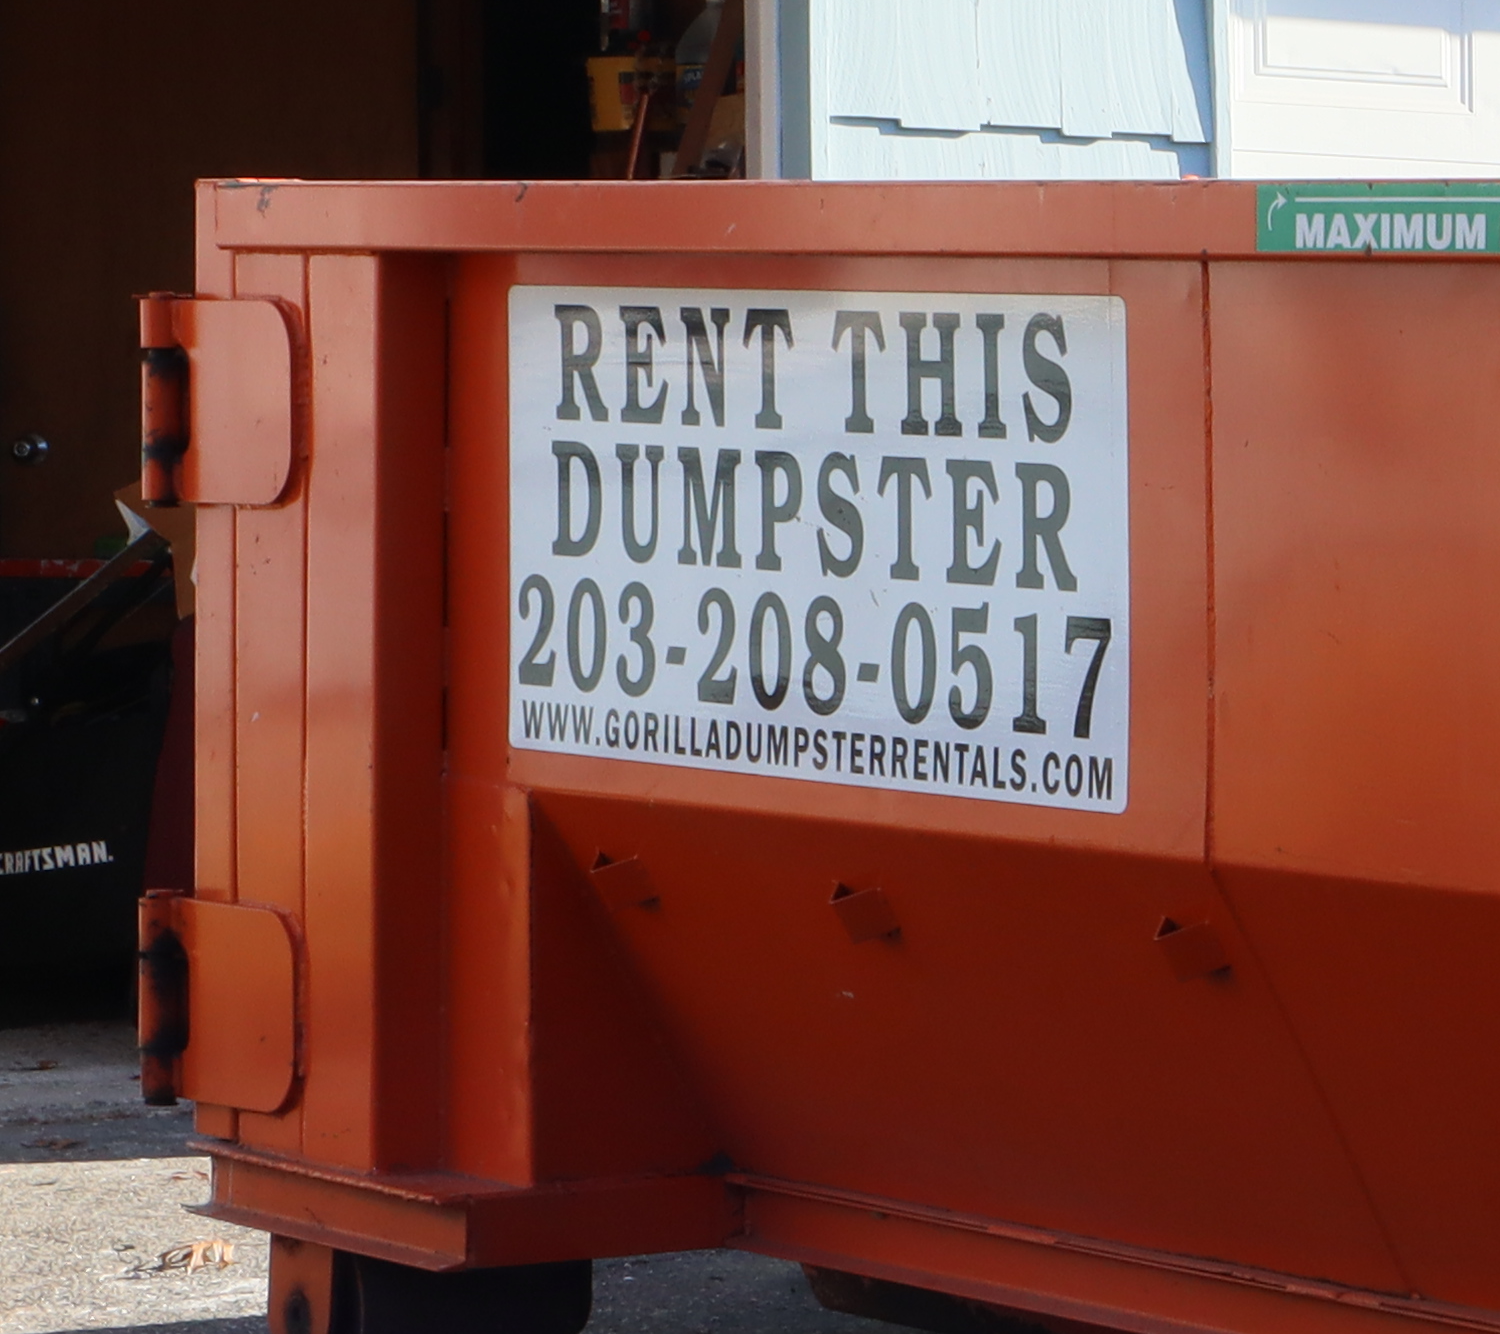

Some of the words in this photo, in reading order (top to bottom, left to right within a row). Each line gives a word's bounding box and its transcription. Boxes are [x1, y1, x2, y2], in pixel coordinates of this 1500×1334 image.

[1295, 213, 1486, 251] MAXIMUM
[554, 304, 794, 430] RENT
[831, 310, 1072, 443] THIS
[551, 440, 1077, 592] DUMPSTER
[518, 573, 1112, 739] 203-208-0517
[522, 699, 1113, 801] WWW.GORILLADUMPSTERRENTALS.COM
